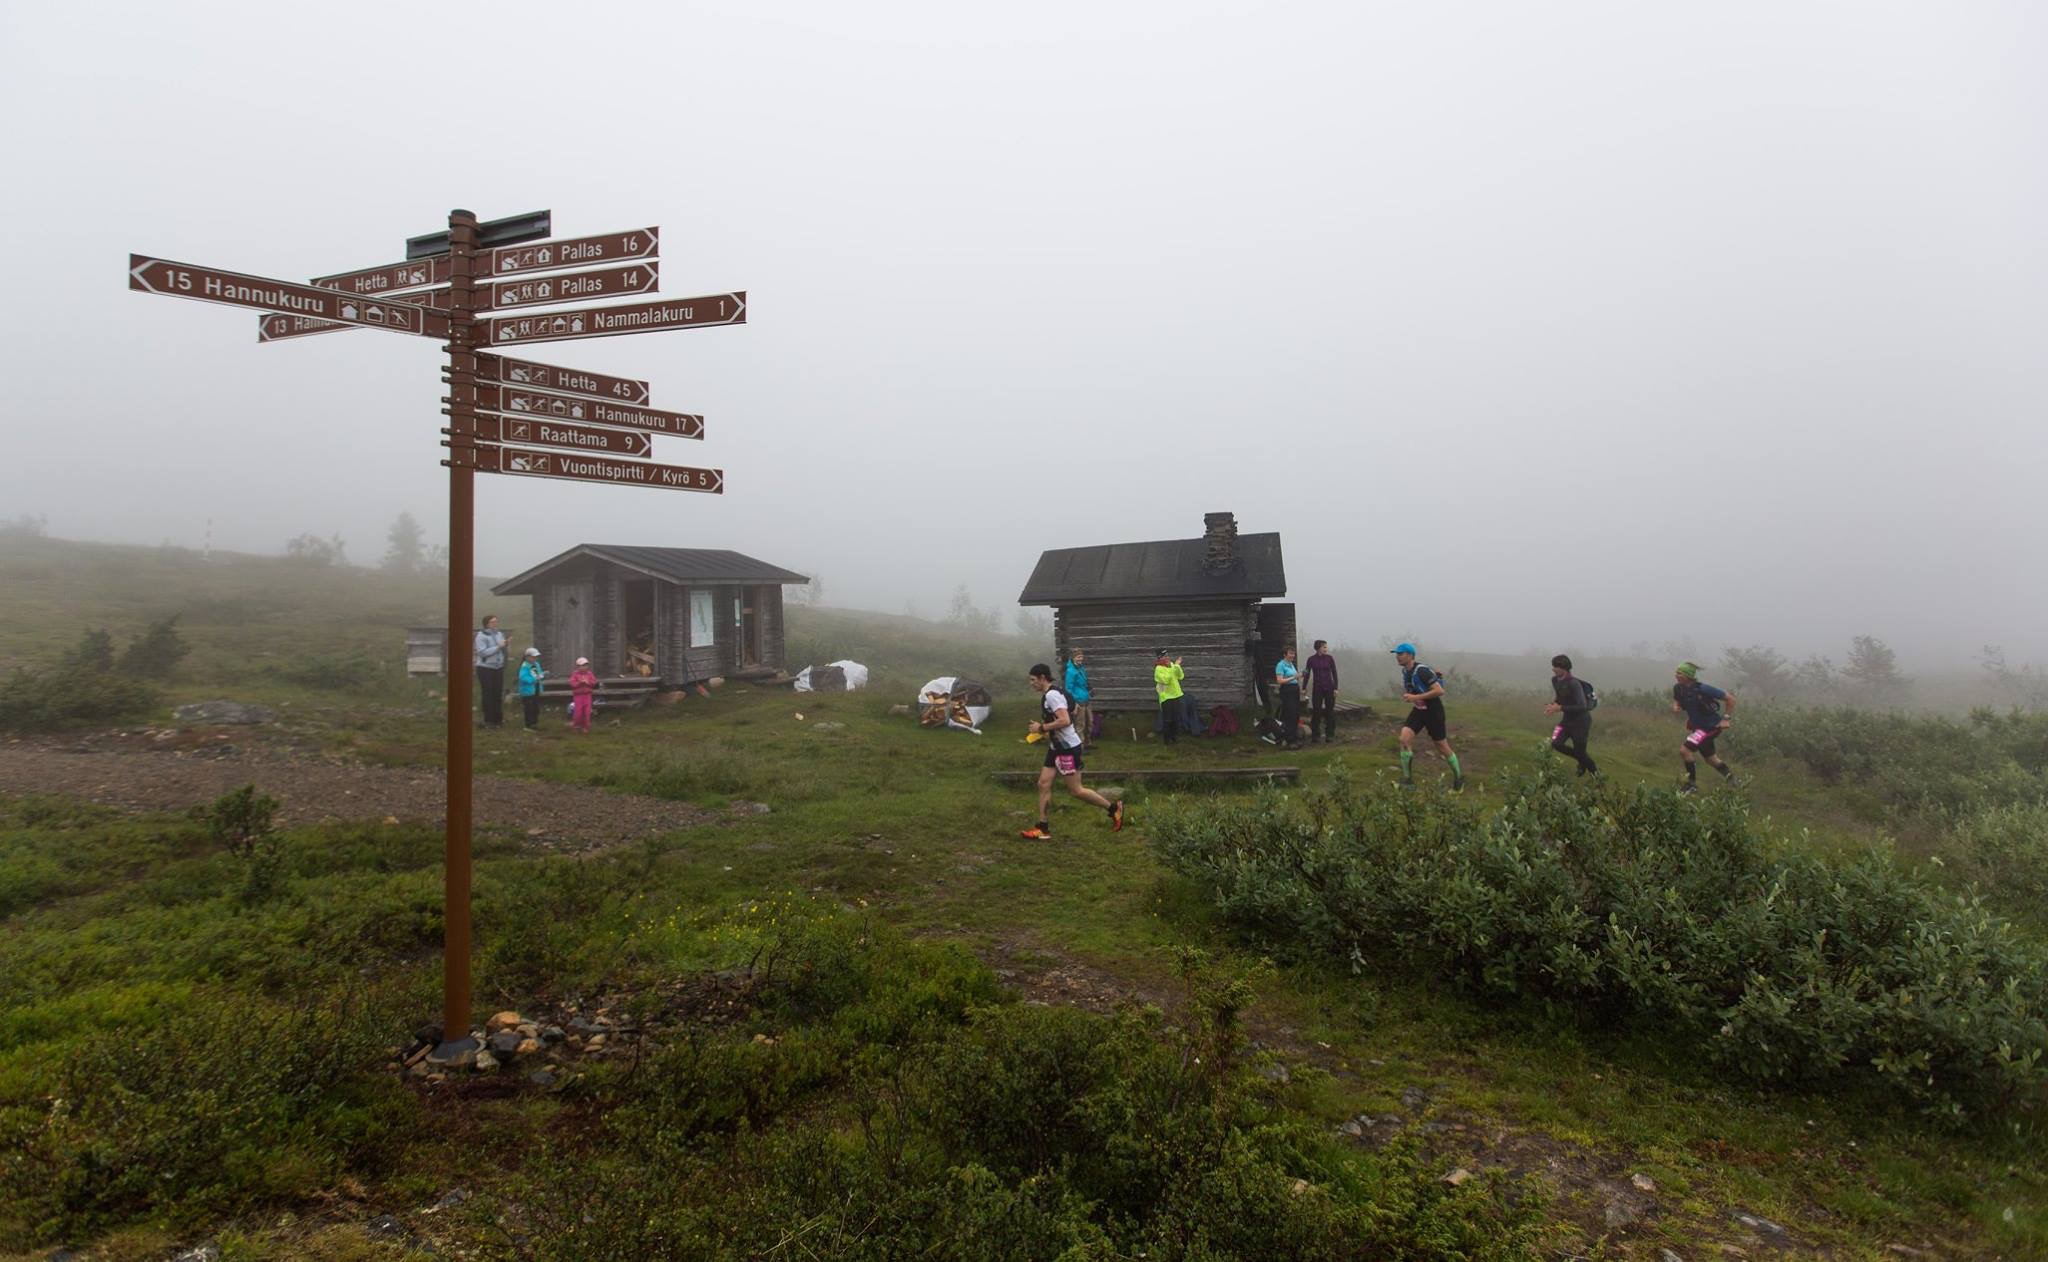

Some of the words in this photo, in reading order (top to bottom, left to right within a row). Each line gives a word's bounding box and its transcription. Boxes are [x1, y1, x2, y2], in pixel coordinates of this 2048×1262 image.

[561, 243, 603, 260] Pallas
[622, 236, 638, 253] 16
[166, 270, 192, 290] 15
[205, 277, 323, 313] Hannukuru
[355, 275, 388, 292] Hetta
[561, 277, 603, 295] Pallas
[622, 271, 638, 287] 14
[595, 306, 693, 328] Nammalakuru
[719, 300, 725, 316] 1
[274, 320, 287, 334] 13
[559, 372, 597, 392] Hetta
[613, 384, 631, 397] 45
[595, 406, 666, 428] Hannukuru
[675, 418, 688, 432] 17
[541, 426, 608, 447] Raattama
[624, 437, 633, 450] 9
[560, 458, 644, 480] Vuontispirtti
[649, 468, 657, 481] /
[662, 470, 690, 485] Kyrö
[699, 473, 707, 486] 5
